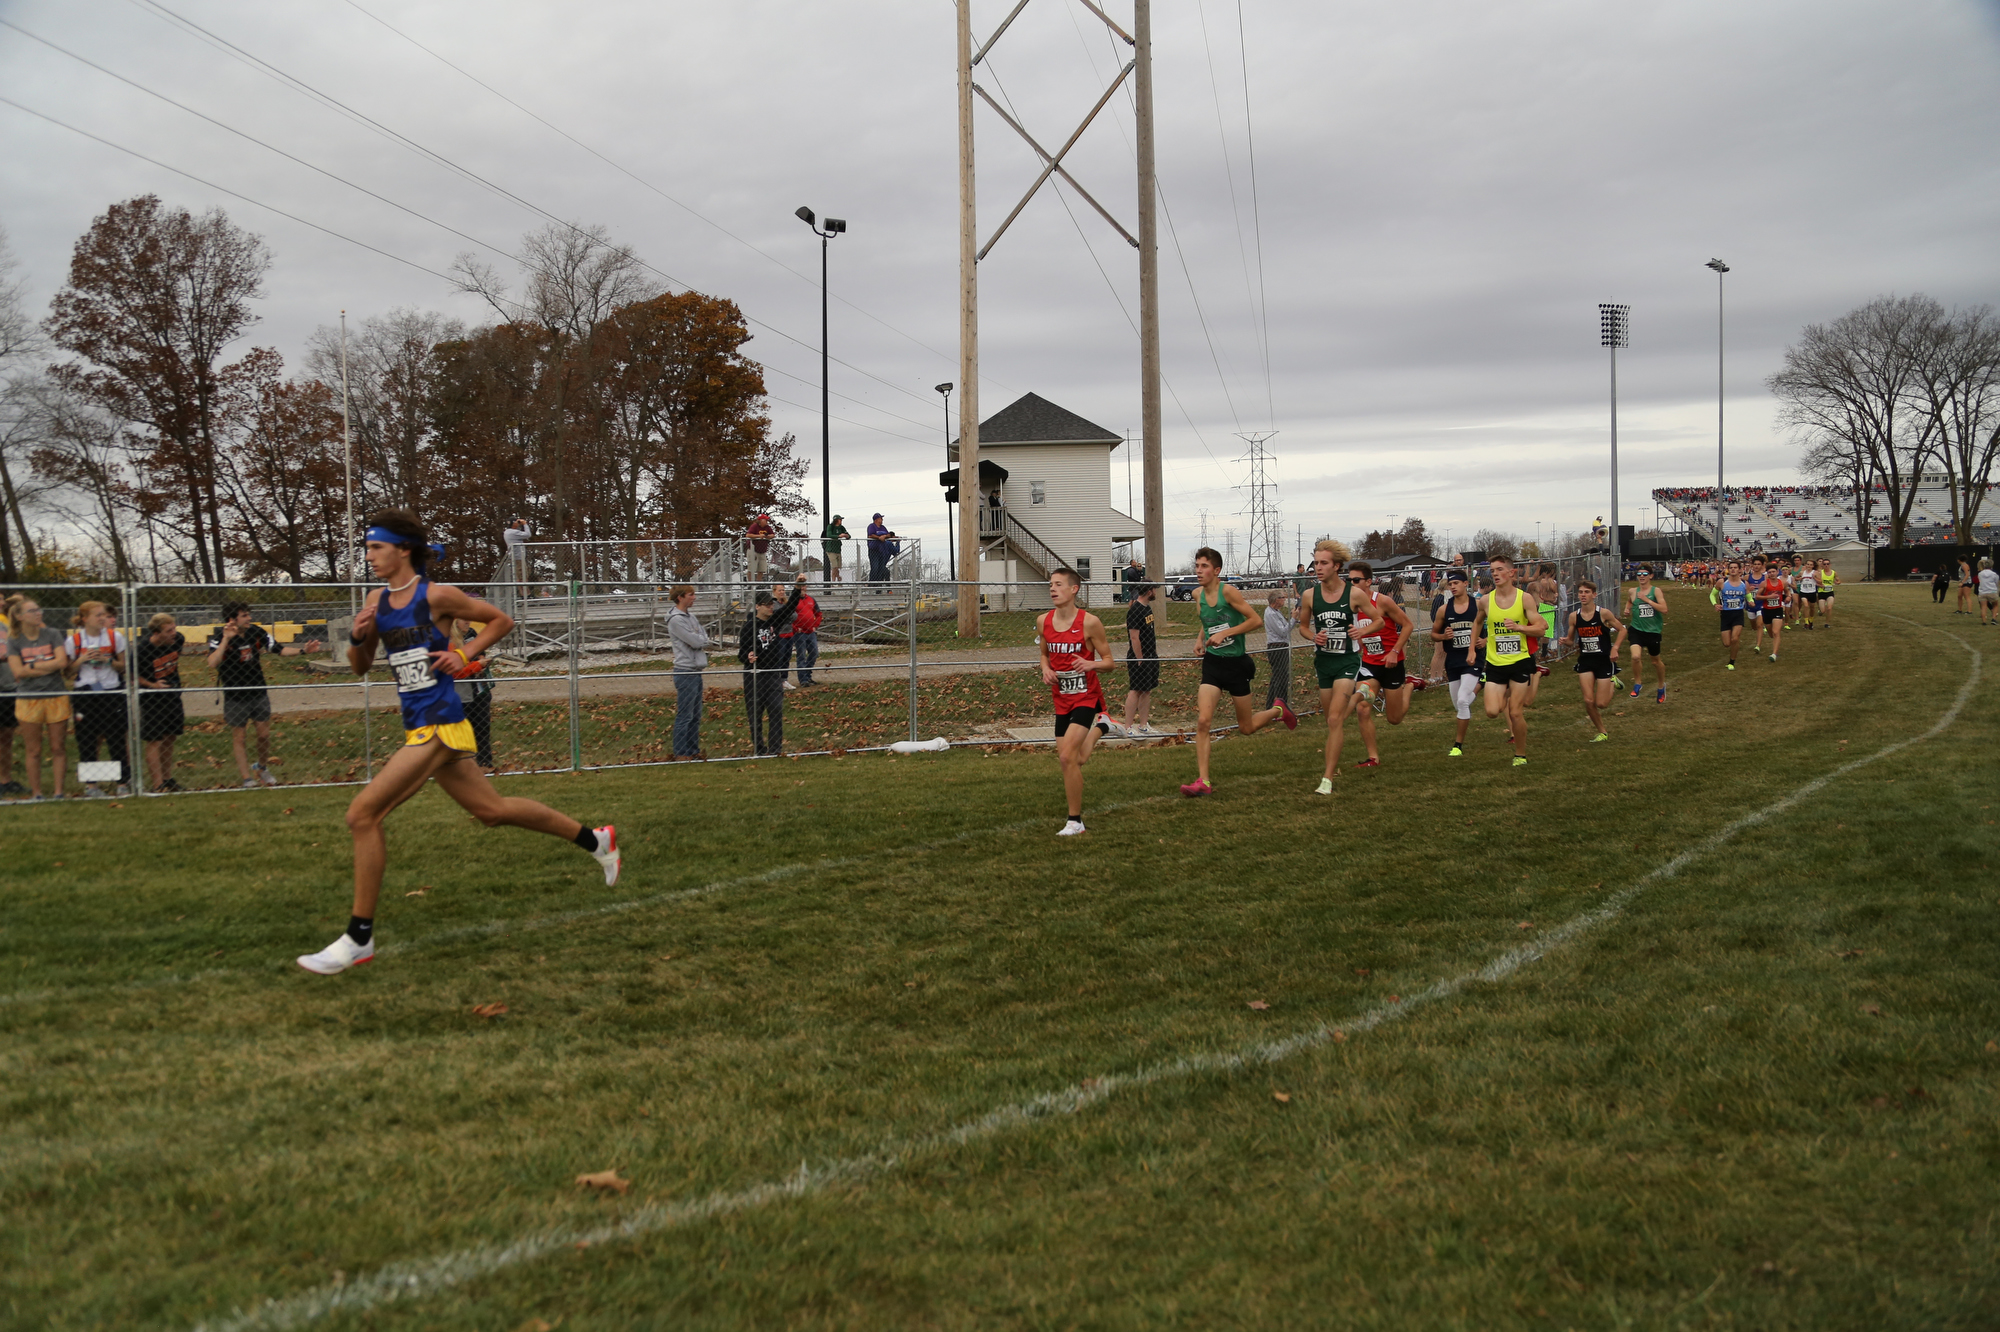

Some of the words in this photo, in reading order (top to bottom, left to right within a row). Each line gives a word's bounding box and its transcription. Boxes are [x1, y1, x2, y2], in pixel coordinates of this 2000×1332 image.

[1317, 611, 1347, 621] TINORA
[1323, 639, 1344, 650] 177
[1453, 636, 1471, 645] 3180
[1498, 642, 1519, 652] 3093
[396, 661, 430, 685] 3052
